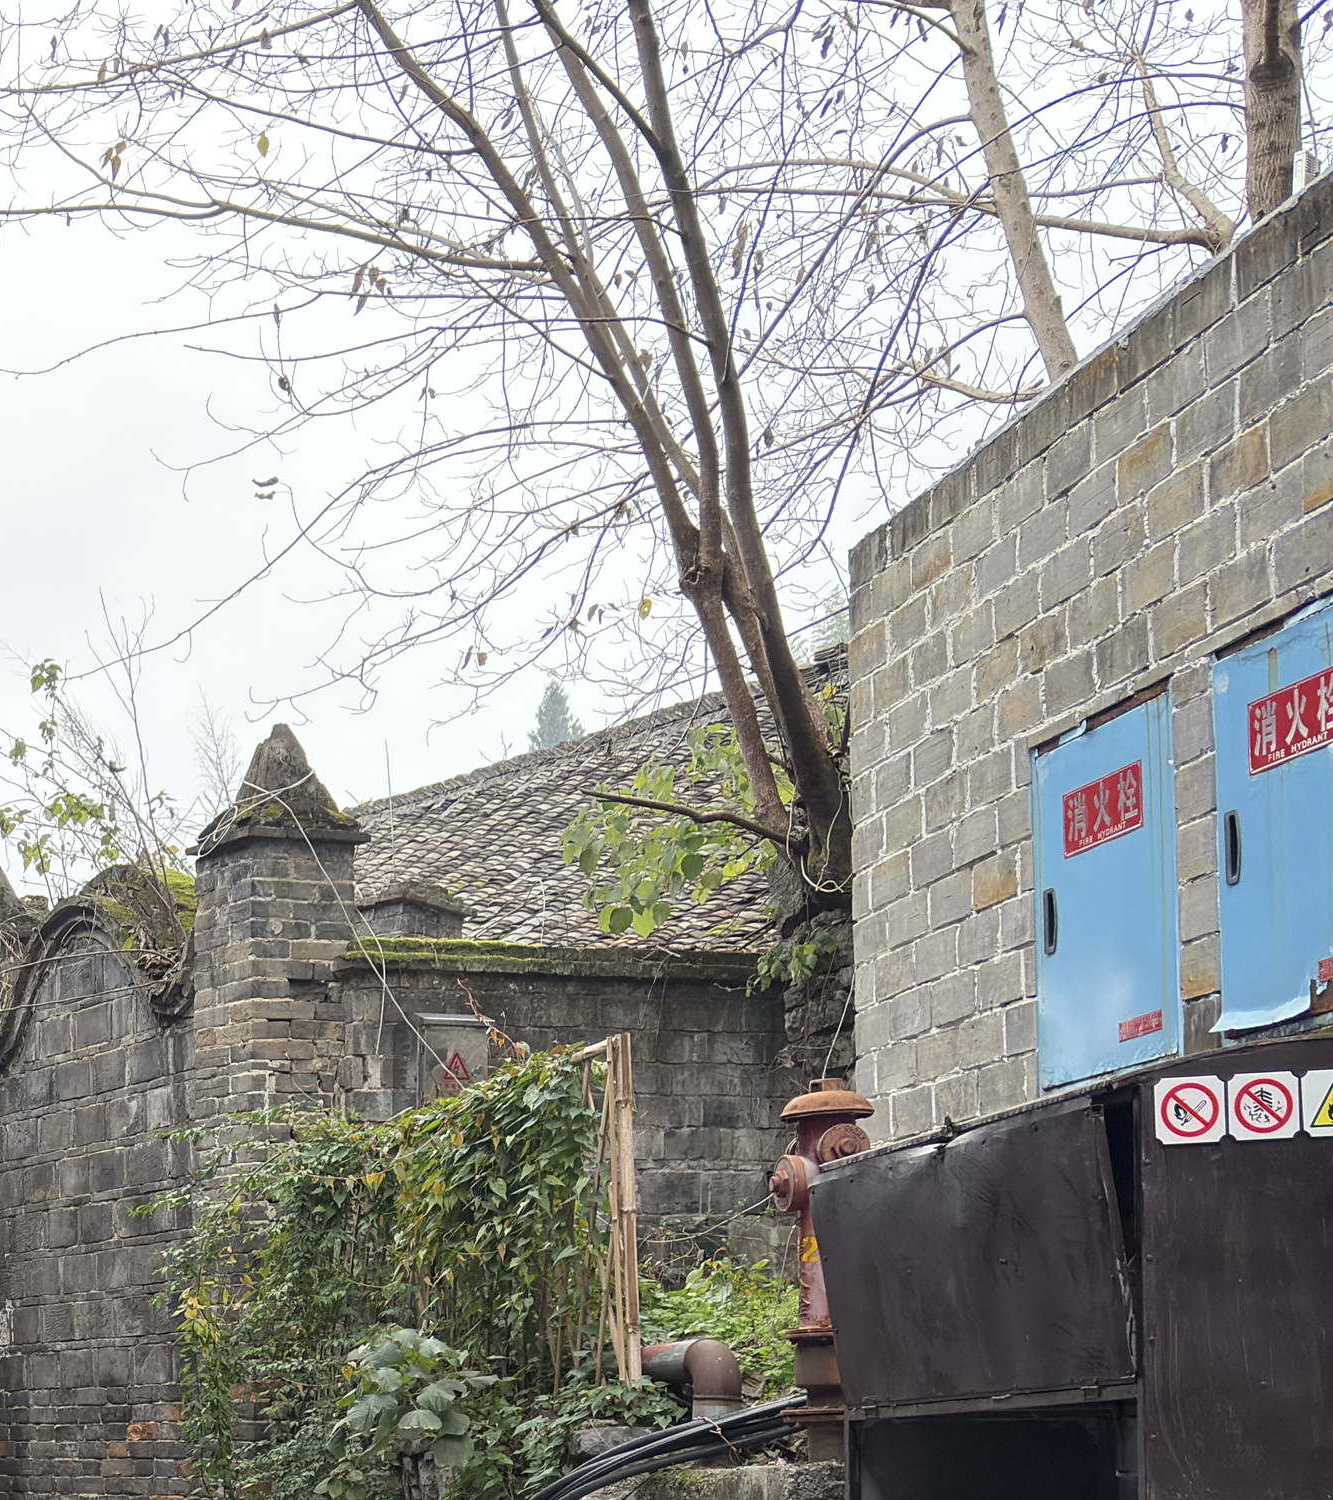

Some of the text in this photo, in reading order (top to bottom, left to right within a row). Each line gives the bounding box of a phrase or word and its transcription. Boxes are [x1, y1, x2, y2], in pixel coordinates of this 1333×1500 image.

[1267, 731, 1329, 763] FIRE HYDRANT
[1067, 769, 1138, 842] 消火栓
[1079, 820, 1127, 848] FIRE HYDRANT
